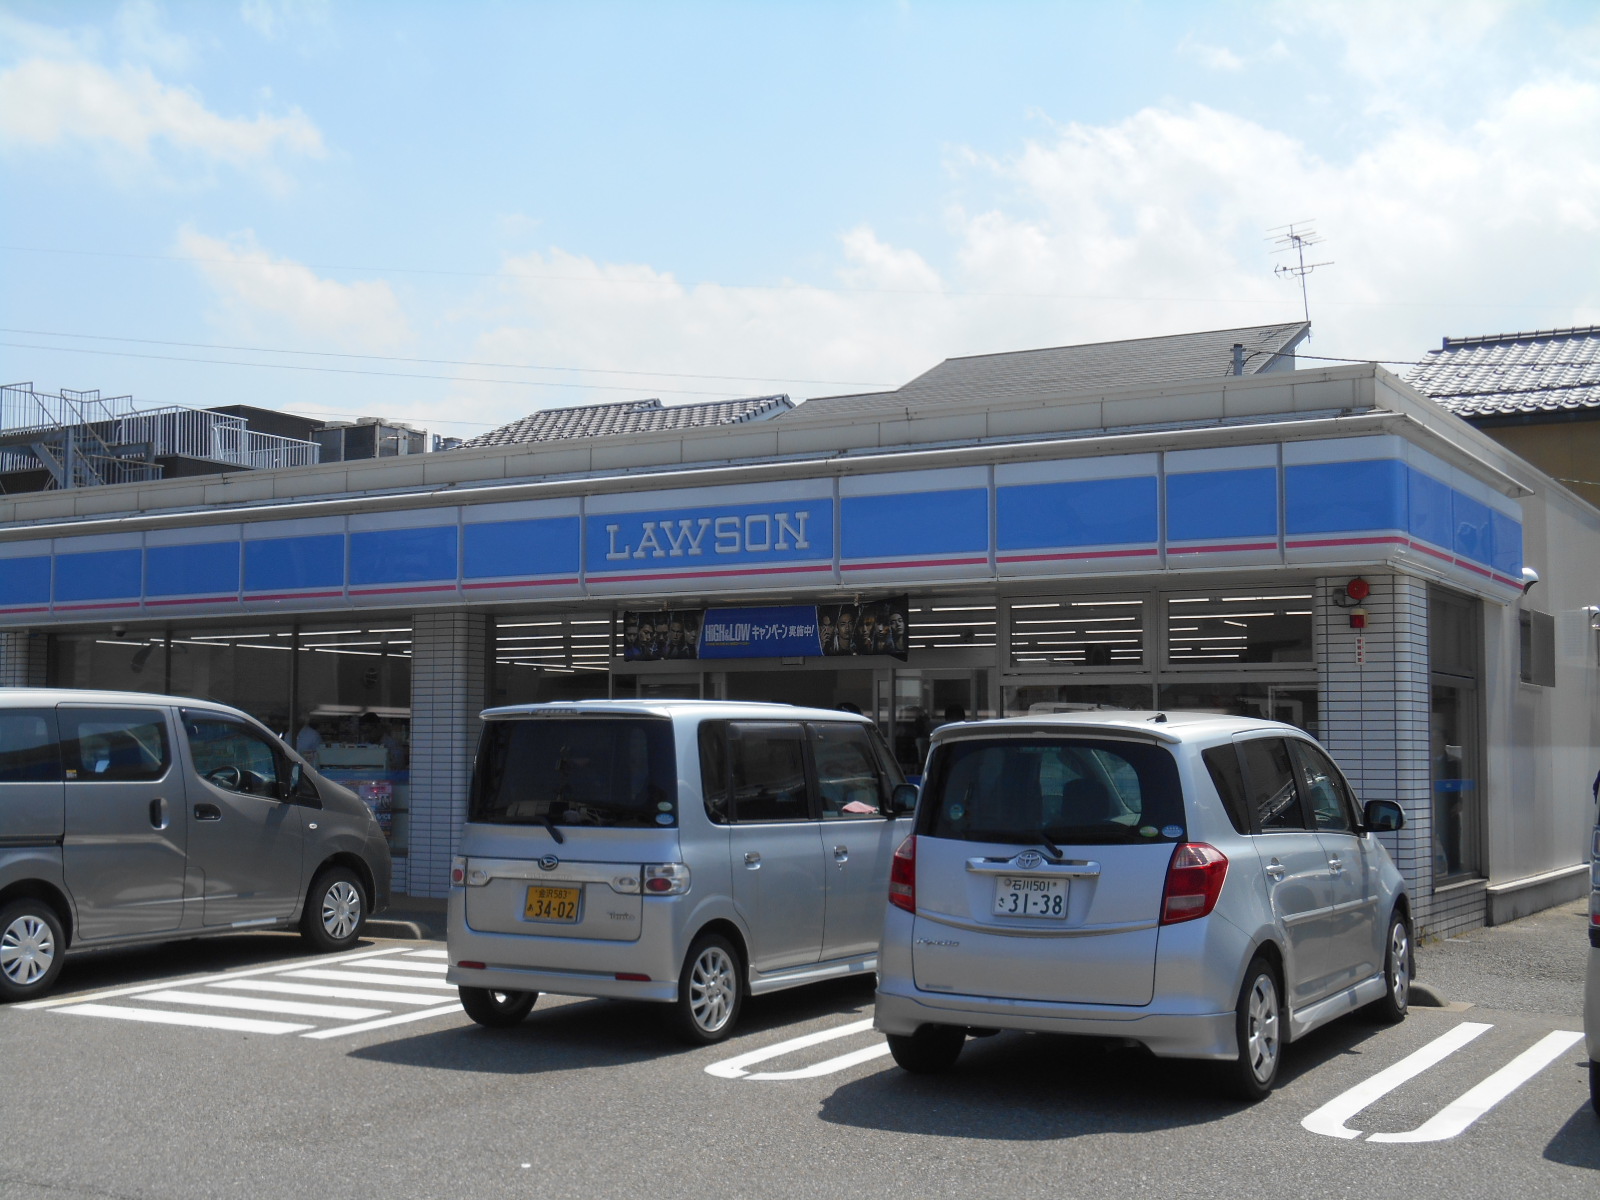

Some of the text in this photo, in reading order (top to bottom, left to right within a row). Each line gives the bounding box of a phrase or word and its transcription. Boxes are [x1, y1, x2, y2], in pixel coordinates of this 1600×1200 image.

[606, 511, 809, 560] LAWSON
[535, 900, 575, 919] 34-02
[1008, 893, 1063, 915] 31-38
